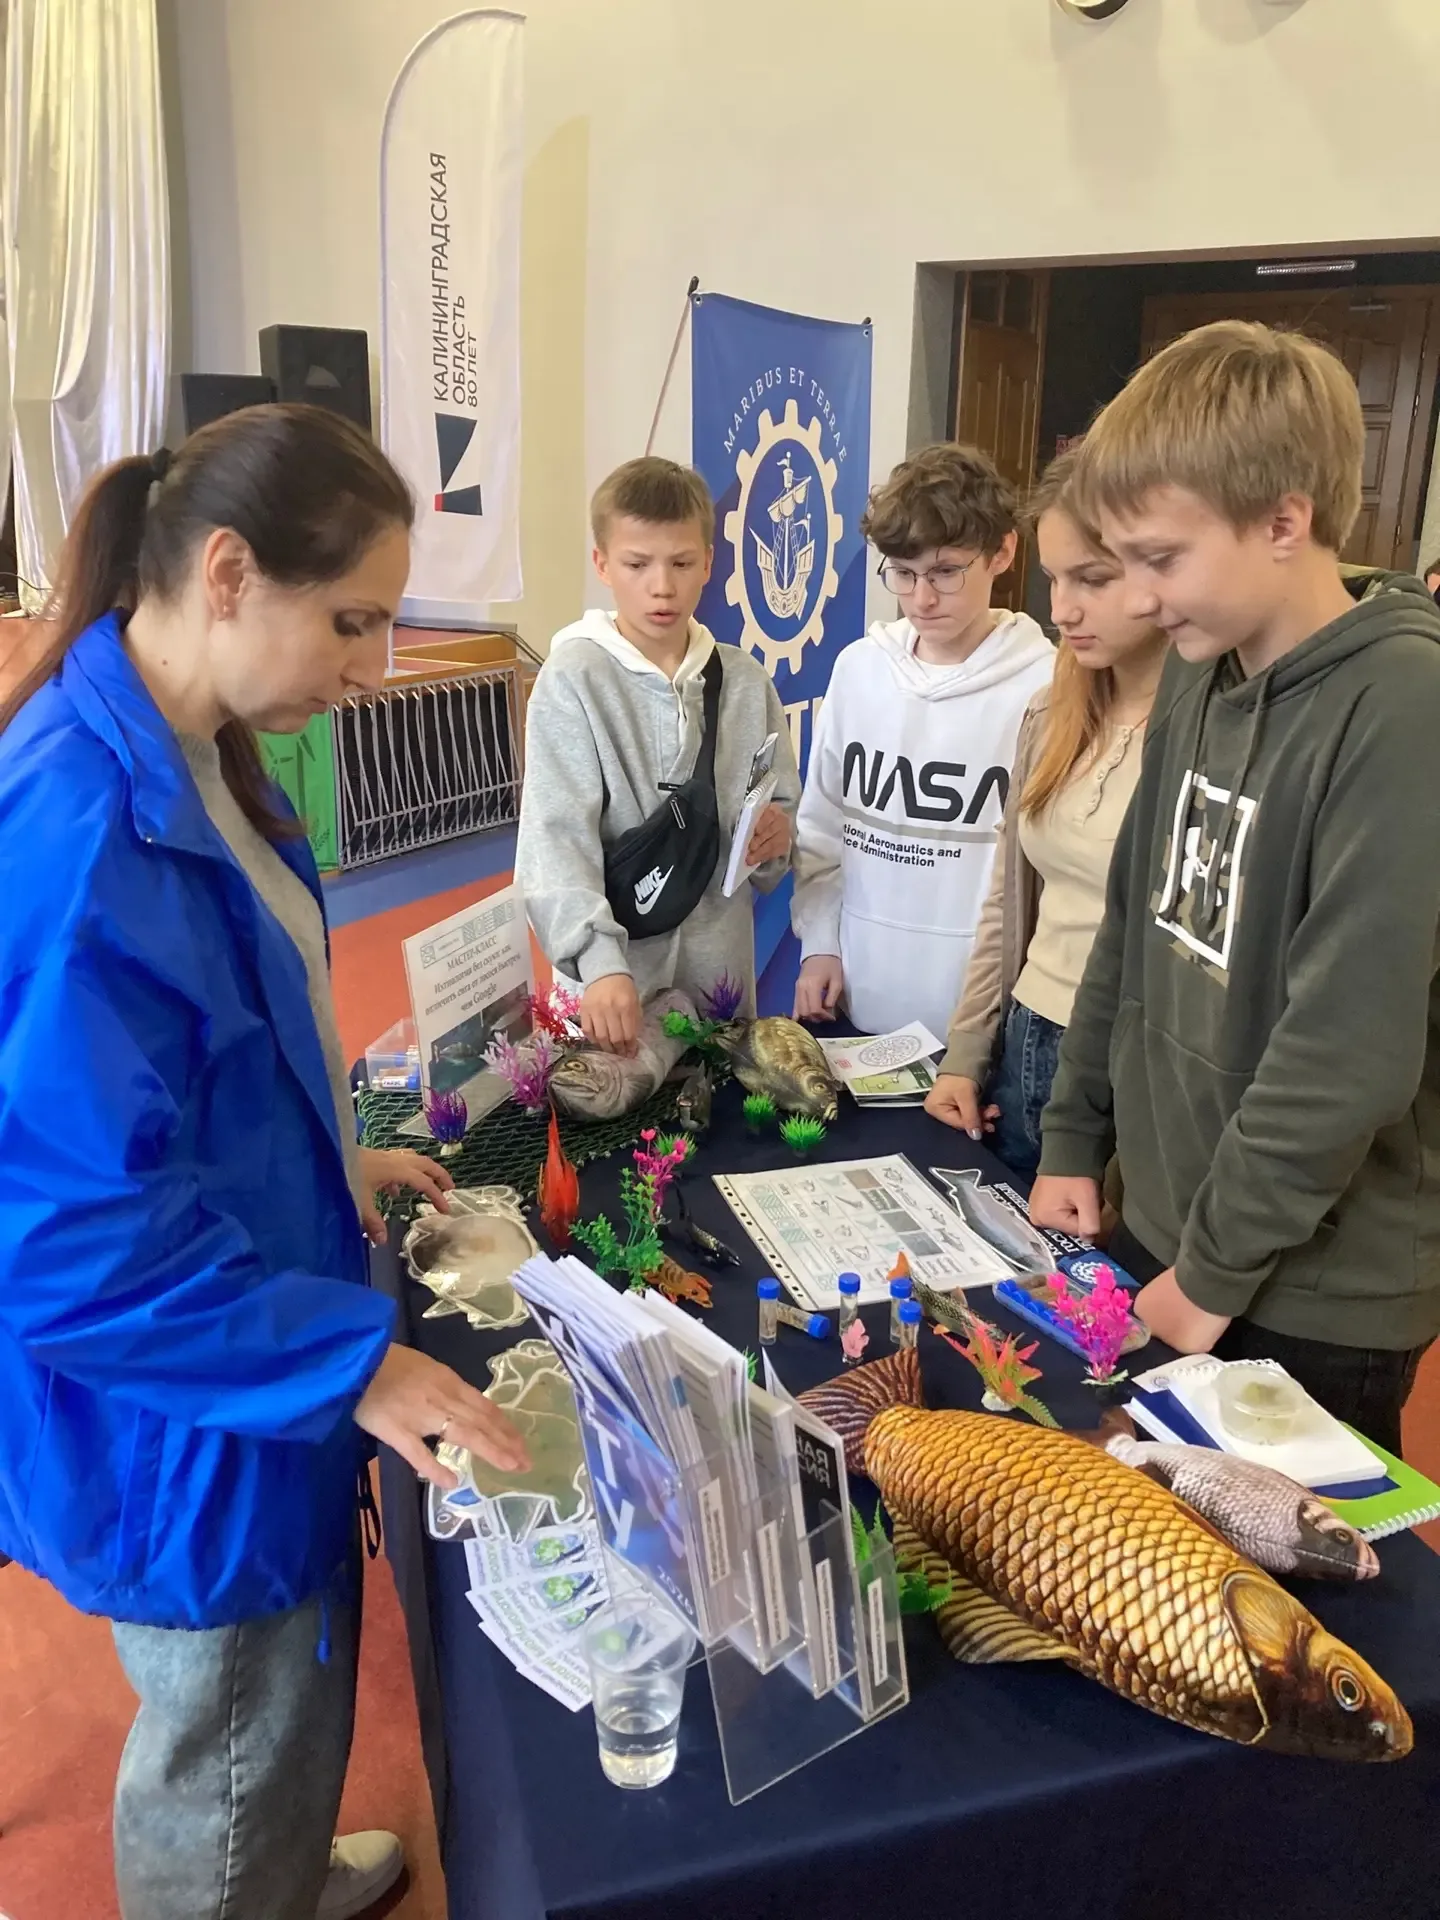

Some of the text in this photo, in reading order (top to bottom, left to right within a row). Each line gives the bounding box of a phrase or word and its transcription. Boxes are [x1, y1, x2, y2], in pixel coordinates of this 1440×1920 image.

[430, 152, 450, 402] КАЛИНИНГРАДСКАЯ
[452, 295, 465, 405] ОБЛАСТЬ
[467, 332, 478, 408] 80 ЛЕТ
[723, 367, 848, 463] MARIBUS ET TERRAE
[843, 741, 1010, 825] NASA
[634, 865, 662, 902] NIKE
[868, 833, 934, 857] Aeronautics
[937, 847, 962, 858] and
[473, 983, 498, 1004] Google
